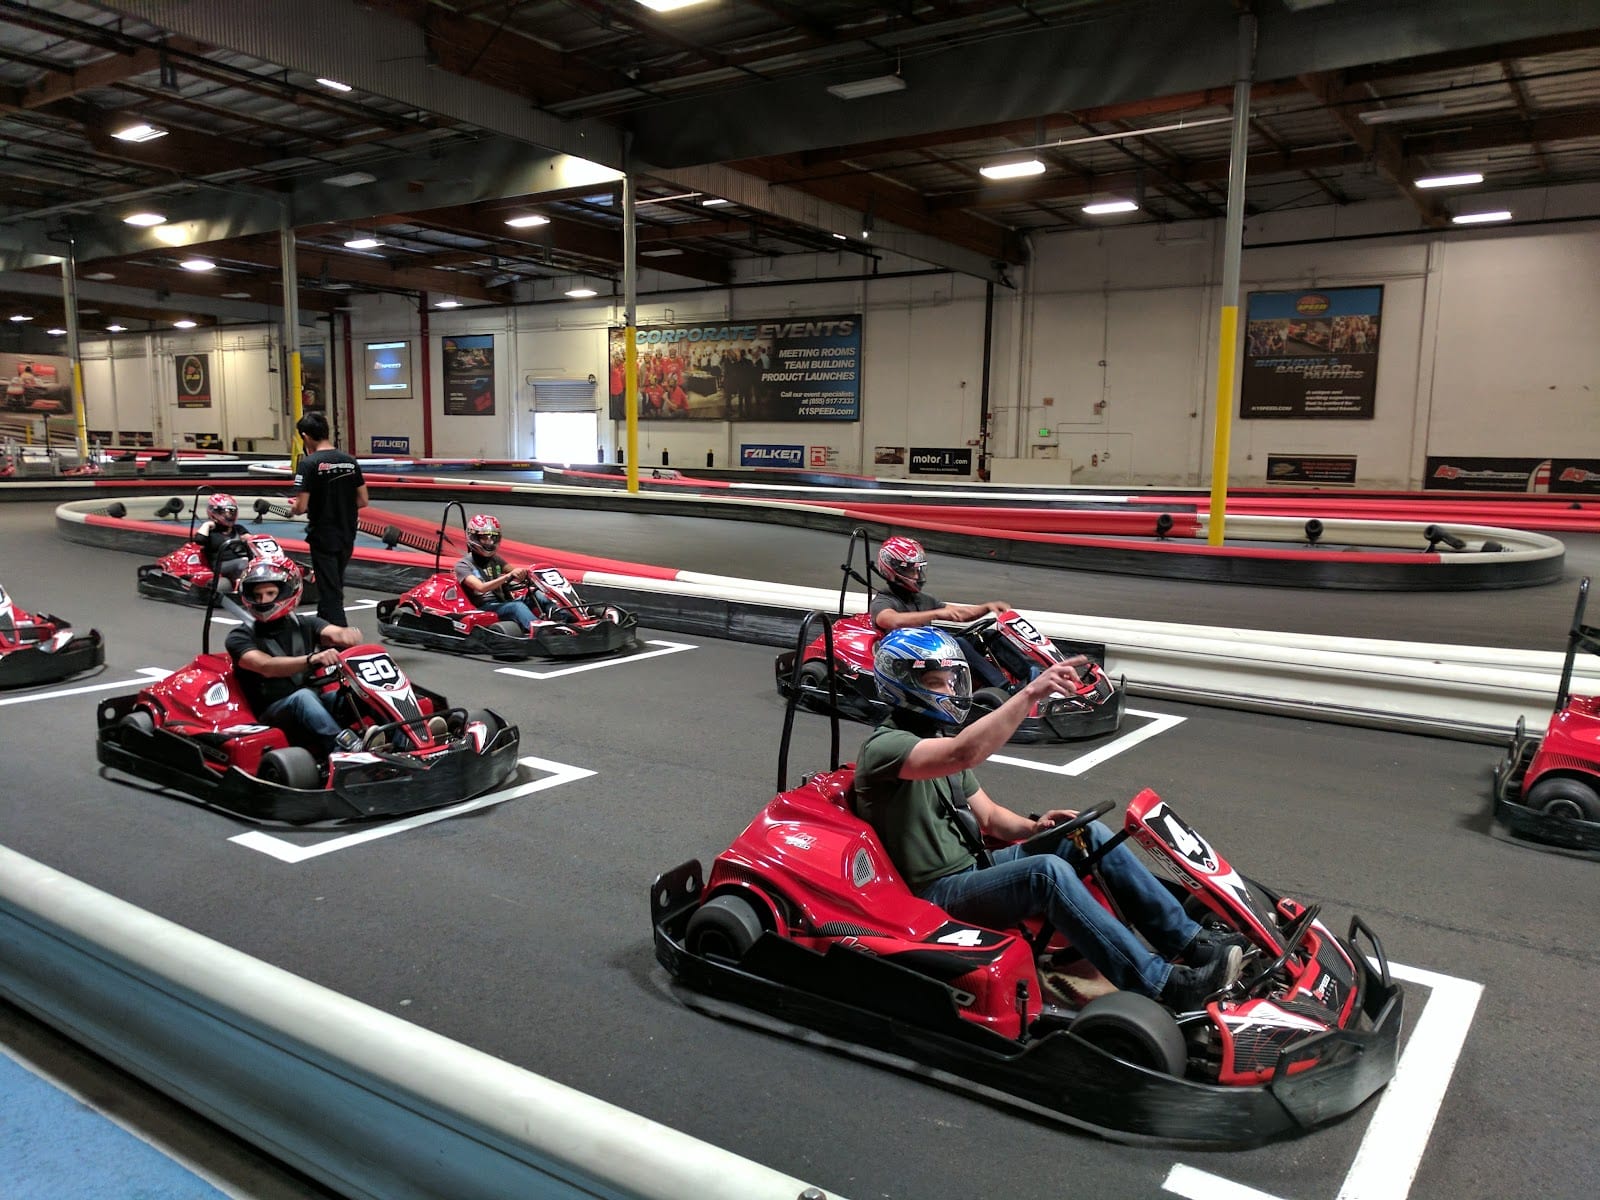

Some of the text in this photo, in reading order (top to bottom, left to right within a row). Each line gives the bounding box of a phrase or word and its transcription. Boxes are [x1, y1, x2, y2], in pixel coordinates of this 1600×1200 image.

[635, 320, 856, 345] CORPORATE EVENTS
[778, 347, 856, 358] MEETING ROOMS
[783, 359, 855, 370] TEAM BUILDING
[761, 371, 855, 382] PRODUCT LAUNCHES
[798, 407, 855, 416] K1SPEED.com
[743, 448, 802, 460] FALKEN
[358, 659, 396, 683] 20
[1162, 813, 1204, 857] 4
[936, 929, 983, 947] 4
